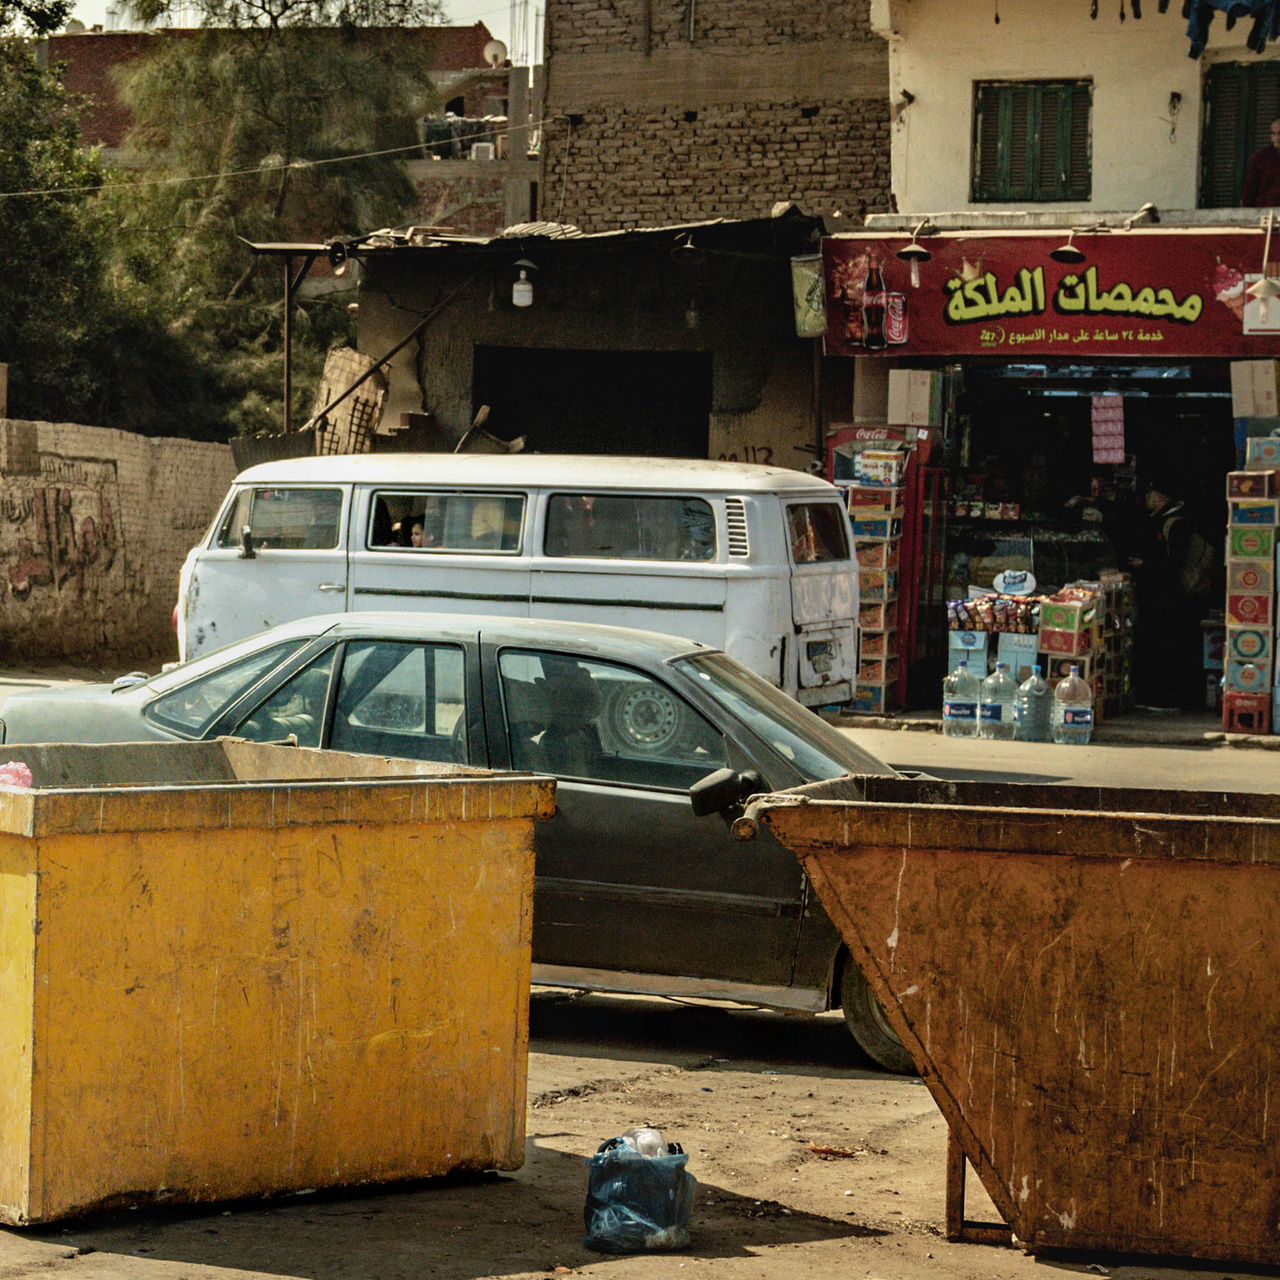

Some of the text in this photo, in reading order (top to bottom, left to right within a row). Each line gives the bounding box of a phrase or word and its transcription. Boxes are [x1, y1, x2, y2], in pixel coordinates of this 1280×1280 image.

[947, 265, 1202, 322] محمصات الملكة
[1048, 328, 1070, 343] مدار
[1093, 328, 1119, 341] ساعة
[1137, 329, 1165, 341] خدمة
